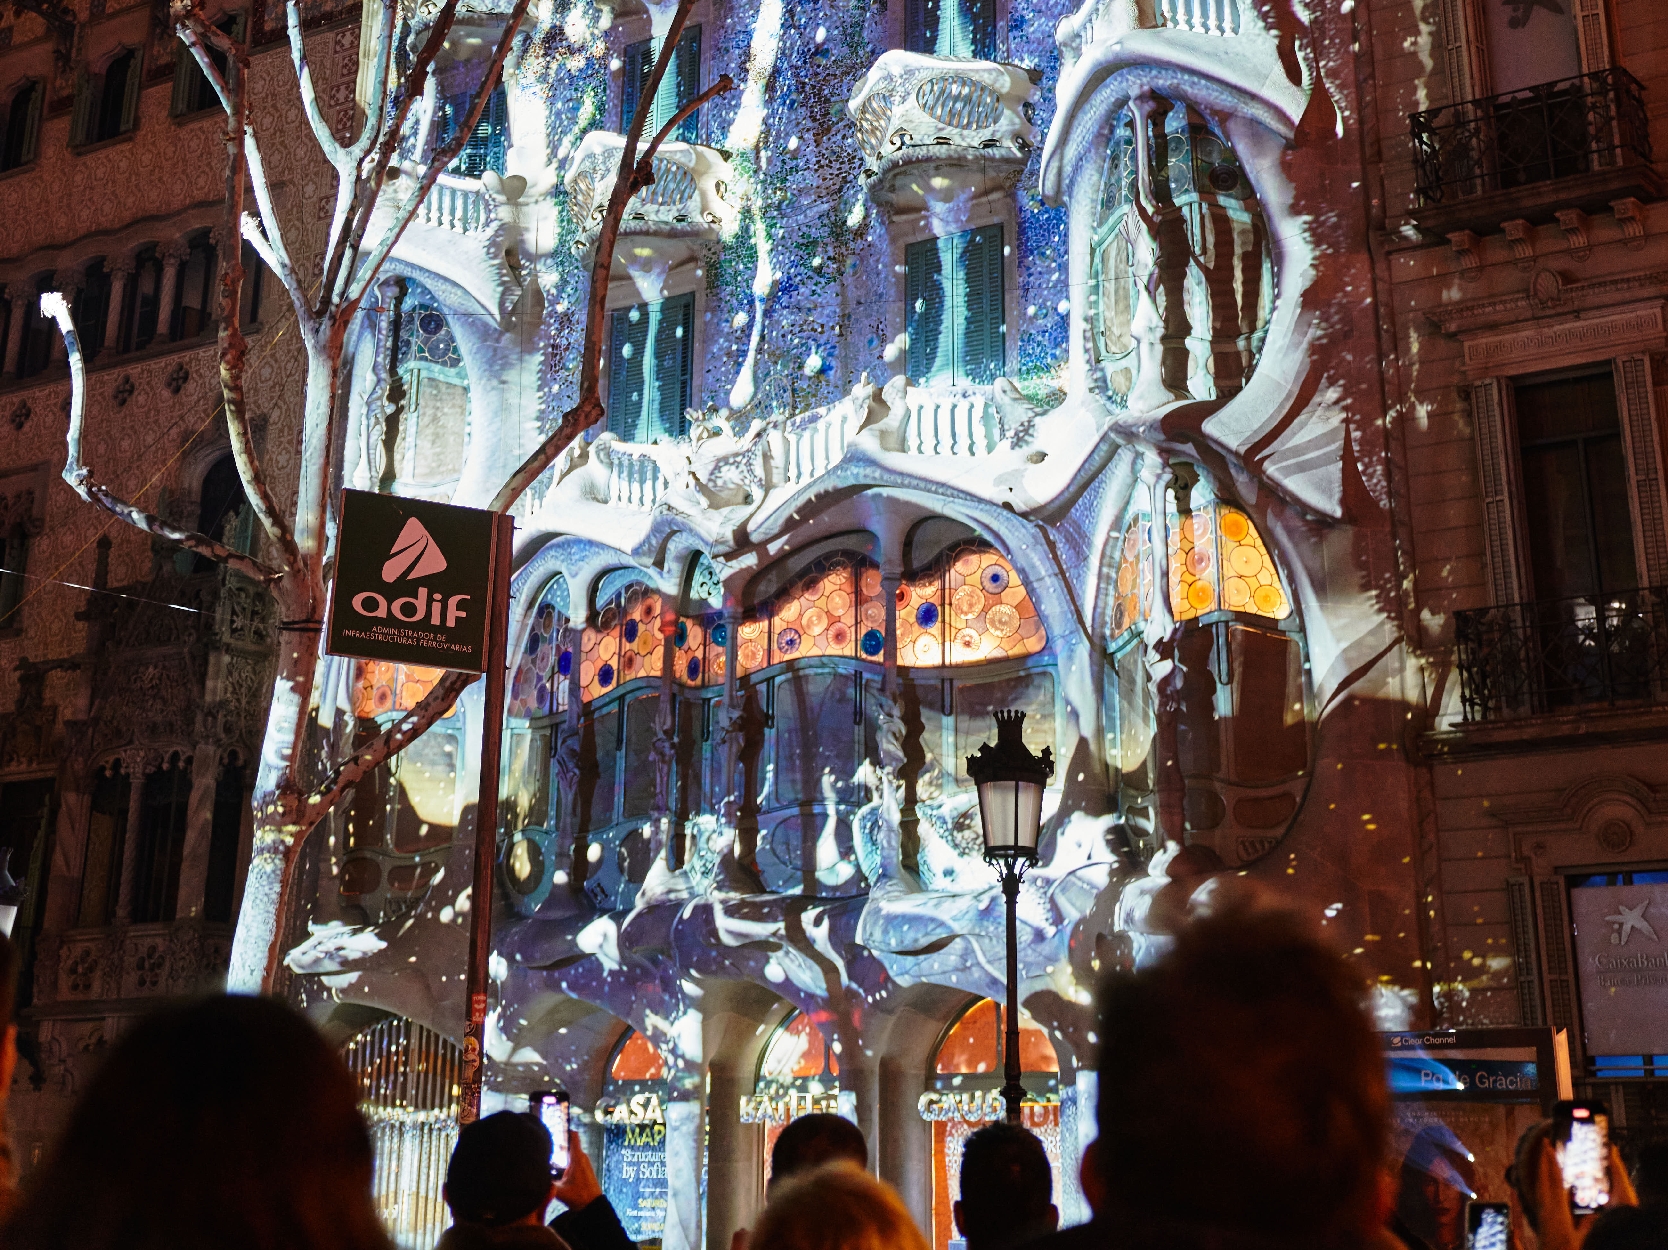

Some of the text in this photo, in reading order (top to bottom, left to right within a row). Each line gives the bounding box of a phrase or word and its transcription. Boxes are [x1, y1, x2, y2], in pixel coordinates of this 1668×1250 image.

[352, 587, 471, 627] adif
[342, 629, 417, 646] INFRAESTRUCTURAS
[1402, 1035, 1457, 1045] Clear Channel
[1421, 1070, 1443, 1090] Pg
[1475, 1071, 1531, 1090] Gràcia
[594, 1093, 664, 1124] CASA
[918, 1091, 1006, 1121] GAUD
[622, 1162, 668, 1182] by Sofia
